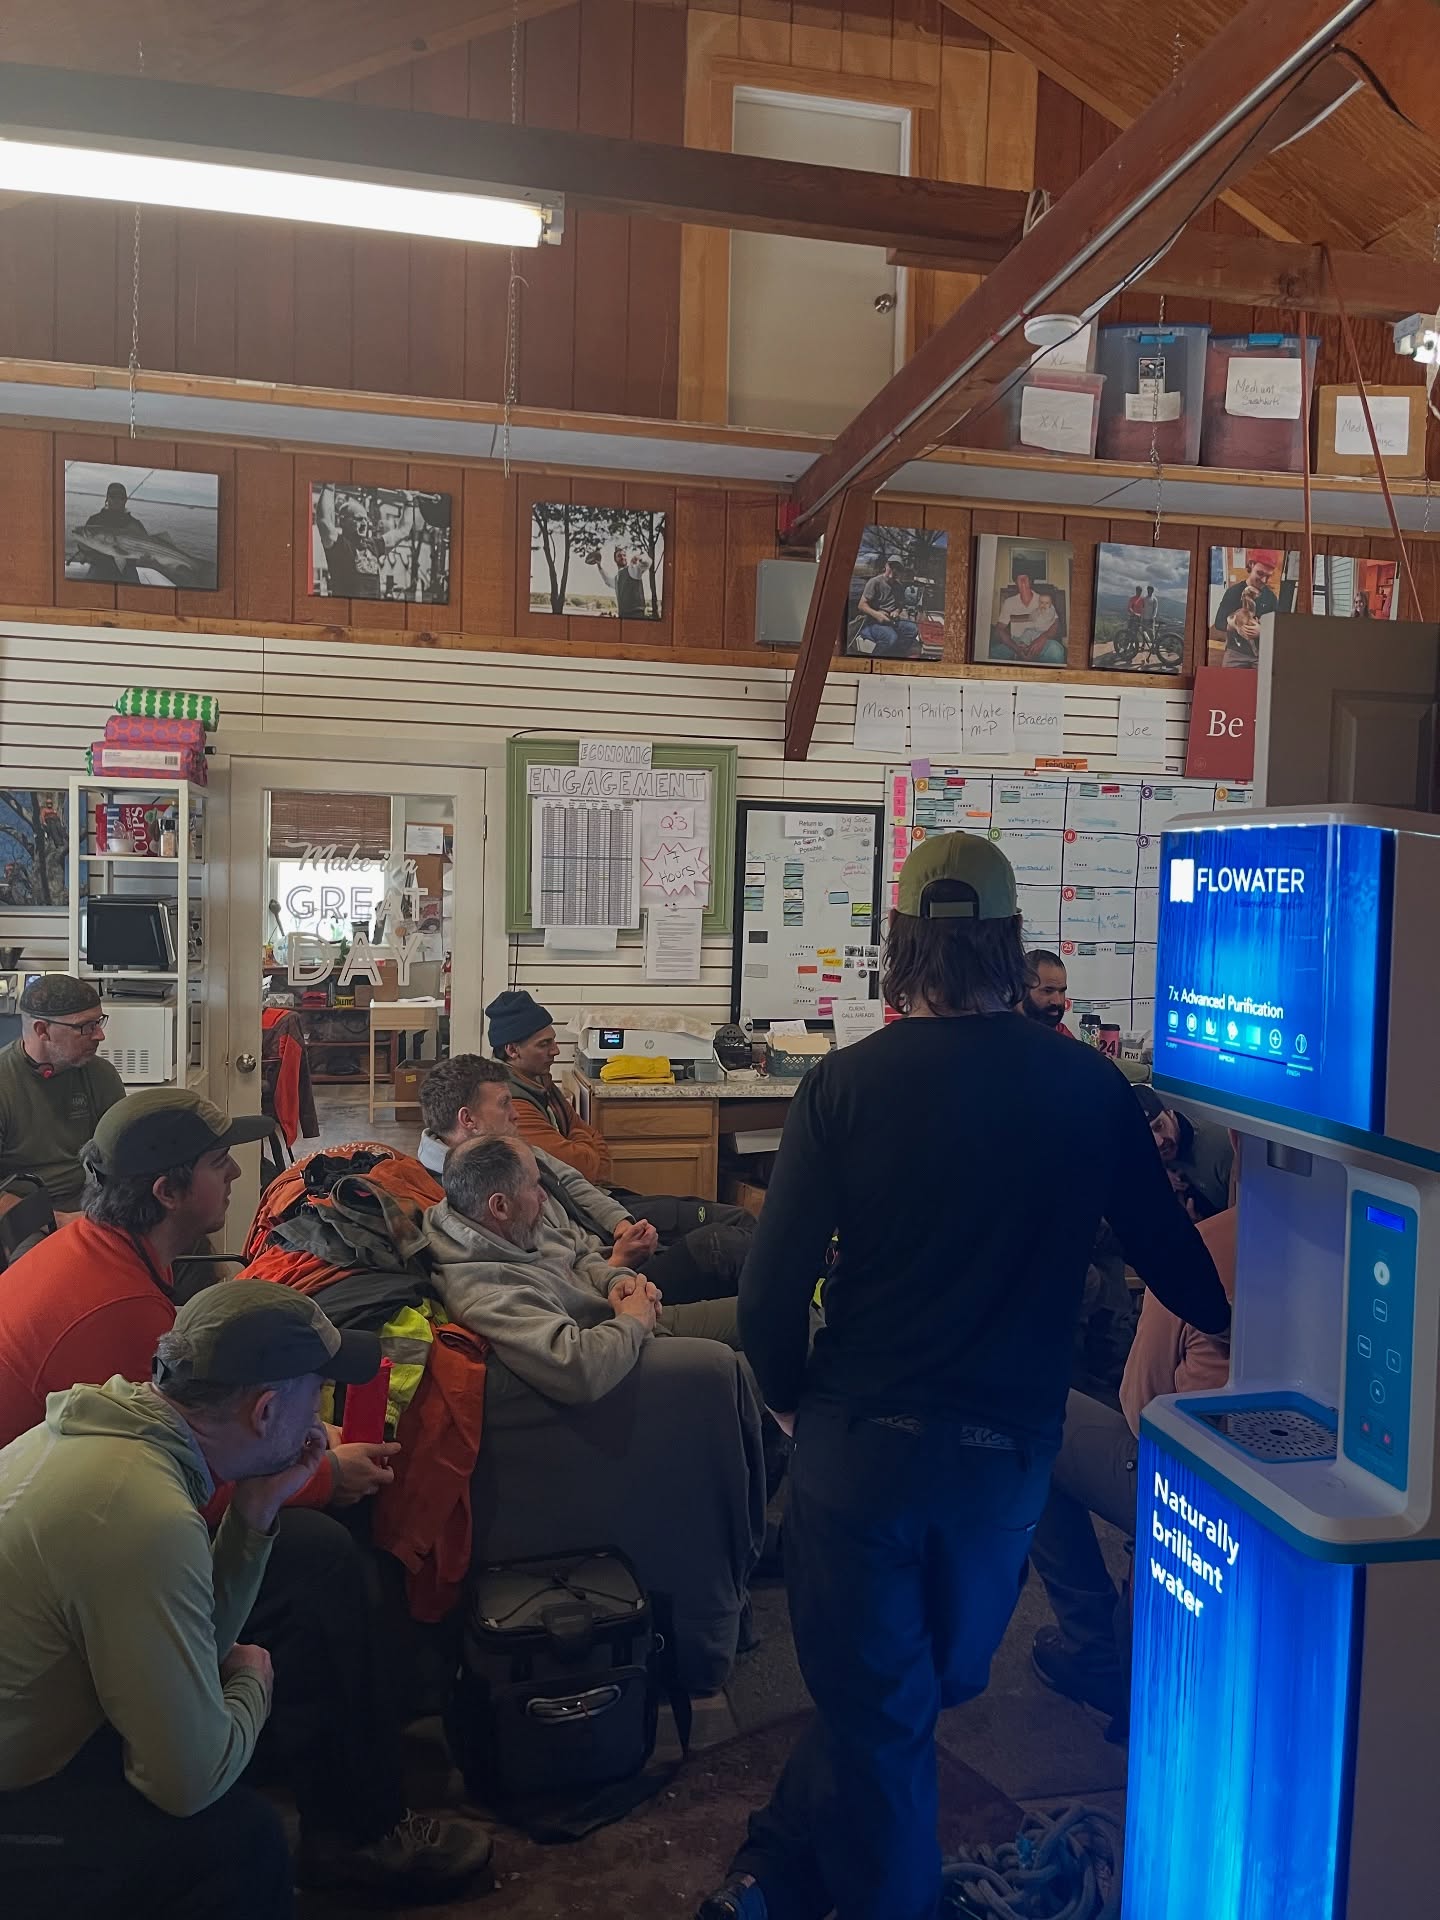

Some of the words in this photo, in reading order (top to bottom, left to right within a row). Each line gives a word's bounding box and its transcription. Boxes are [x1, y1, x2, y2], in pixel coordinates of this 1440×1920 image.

[1040, 415, 1073, 430] XXL
[862, 702, 904, 719] Mason
[919, 702, 956, 721] Philip
[970, 704, 1003, 718] Nate
[1017, 713, 1058, 726] Braeden
[1124, 719, 1152, 737] Joe
[1206, 709, 1244, 738] Be
[580, 743, 652, 764] ECONOMIC
[1045, 759, 1077, 770] February
[529, 767, 706, 798] ENGAGEMENT
[131, 806, 149, 853] CUPS
[661, 815, 688, 831] Q3
[284, 839, 374, 874] Make
[402, 859, 419, 874] a
[663, 851, 680, 866] 17
[800, 845, 823, 854] Possible
[1197, 866, 1306, 894] FLOWATER
[286, 885, 429, 922] GREAT
[287, 931, 425, 987] DAY
[1168, 985, 1180, 1002] 7x
[1180, 988, 1226, 1010] Advanced
[1227, 994, 1284, 1020] Purification
[1099, 1039, 1117, 1057] 24
[1124, 1051, 1139, 1060] PENS
[1154, 1471, 1240, 1566] Naturally
[1152, 1510, 1223, 1594] brilliant
[1150, 1557, 1204, 1618] water
